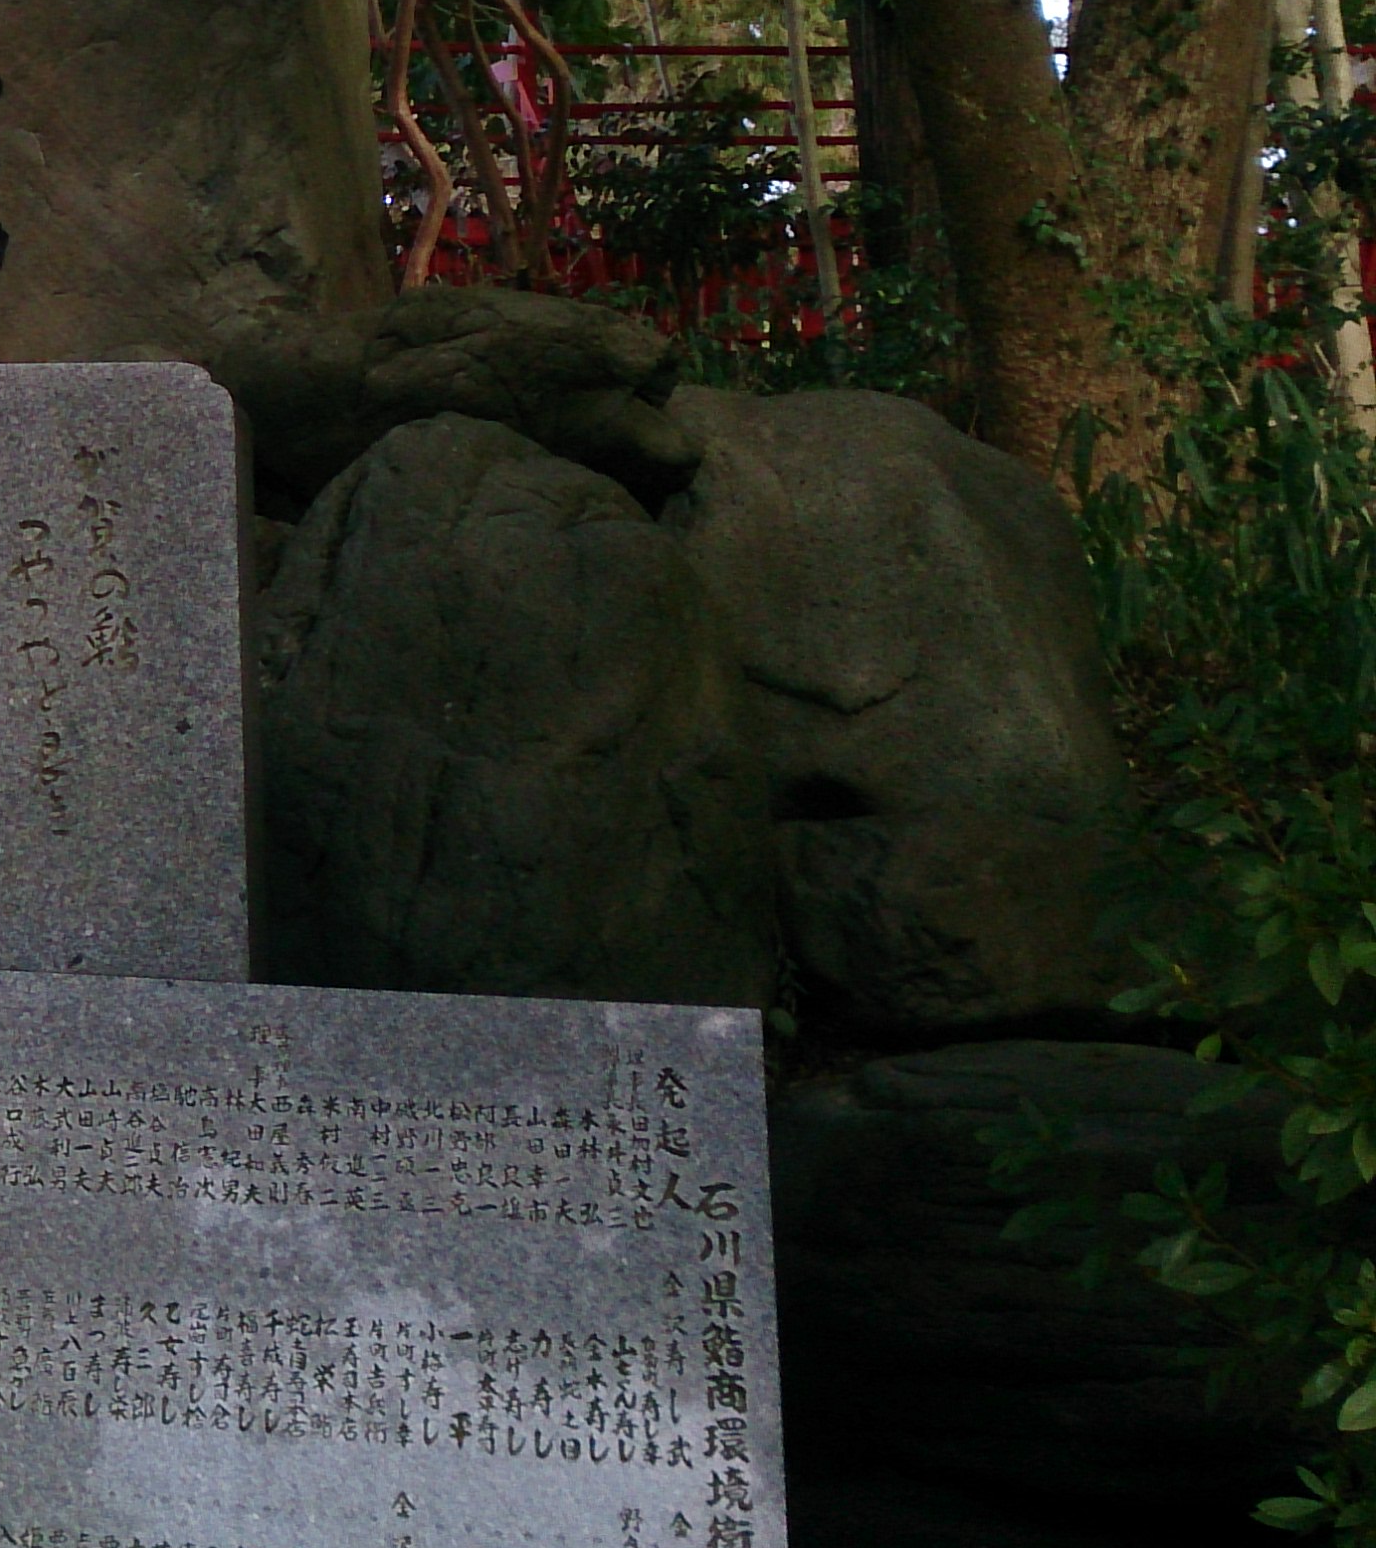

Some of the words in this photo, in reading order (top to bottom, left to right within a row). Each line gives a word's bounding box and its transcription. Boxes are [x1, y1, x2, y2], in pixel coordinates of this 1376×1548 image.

[69, 1078, 99, 1194] 山田一夫
[654, 1066, 692, 1210] 発起人
[448, 1323, 473, 1453] 一平
